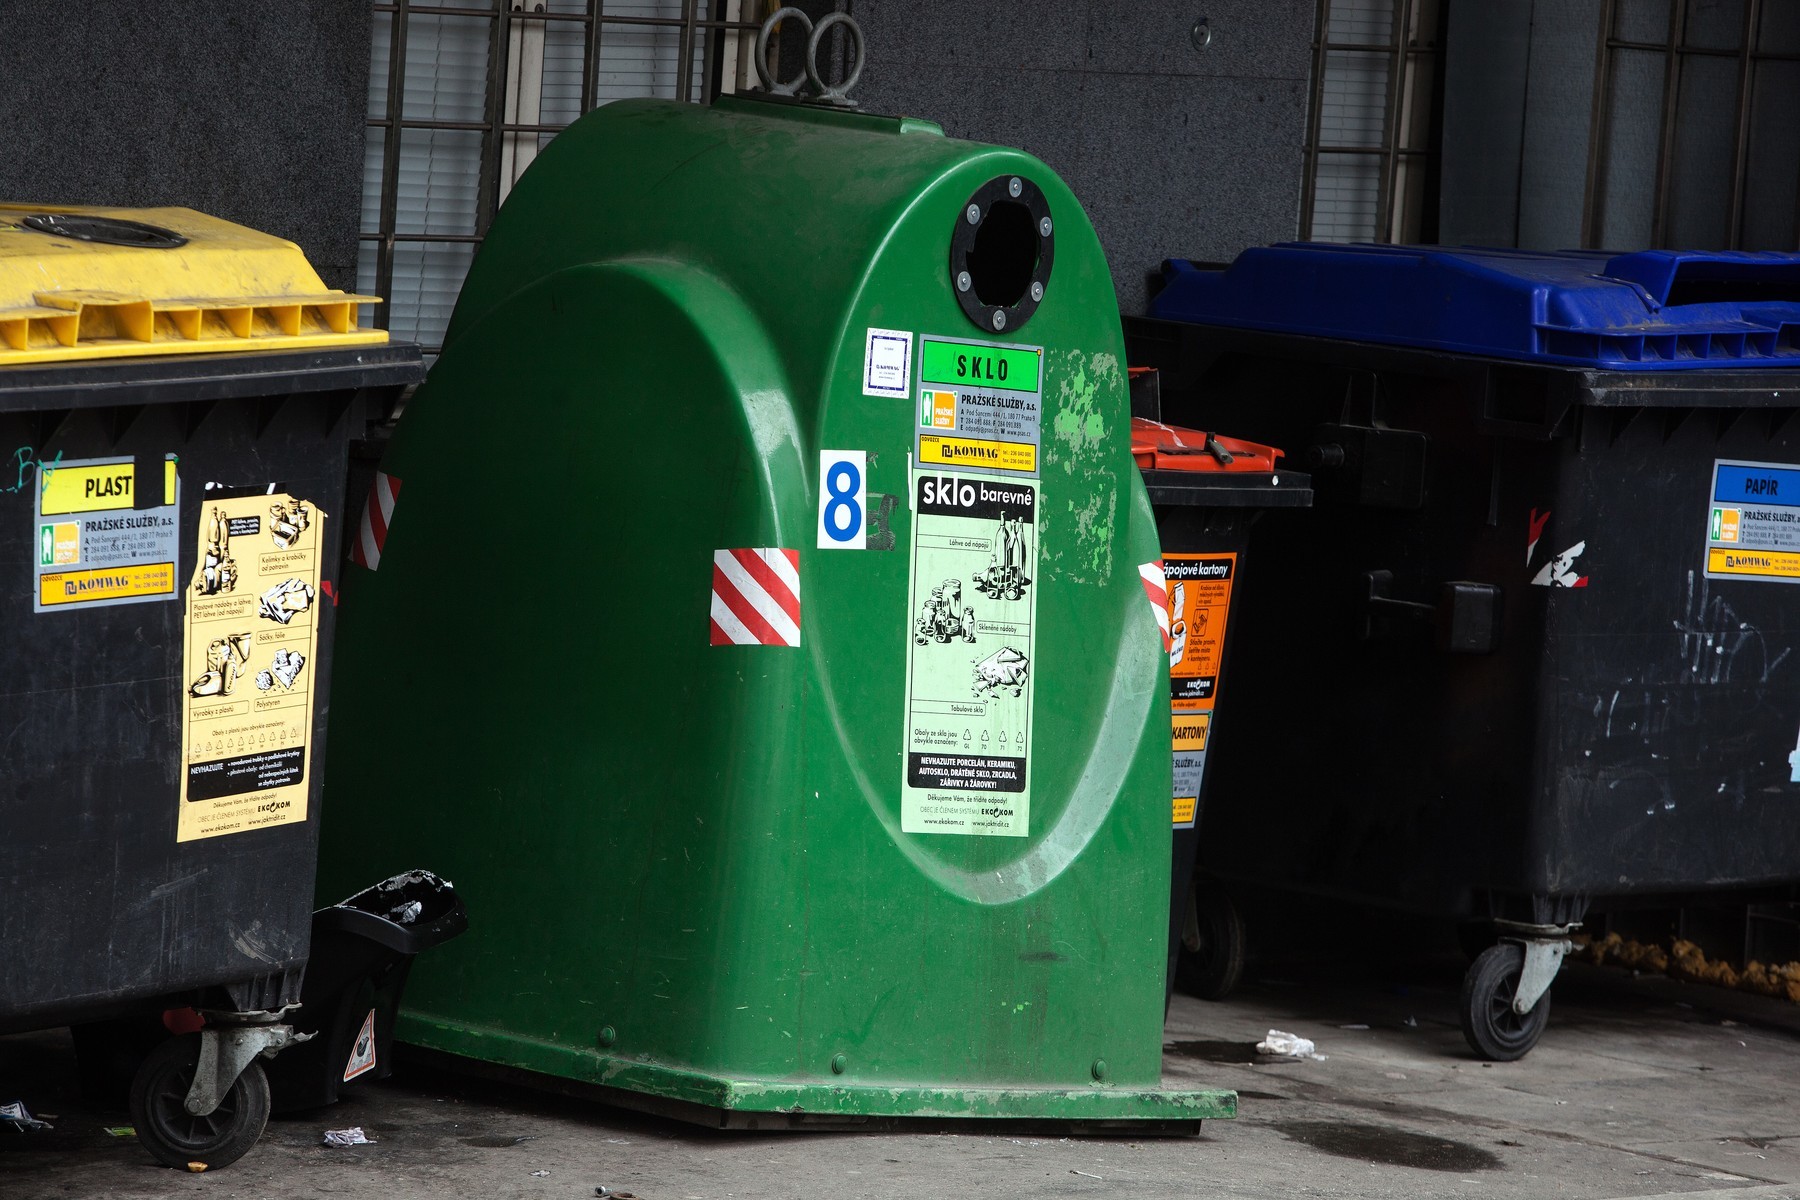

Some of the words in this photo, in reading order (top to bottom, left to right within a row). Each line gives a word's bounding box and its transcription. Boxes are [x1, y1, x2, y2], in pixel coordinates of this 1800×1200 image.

[957, 354, 1008, 381] SKLO
[961, 394, 996, 407] PRAŽSKÉ
[997, 397, 1026, 411] SLUŽBY,
[1026, 403, 1037, 411] a.s.
[953, 446, 999, 459] KOMWAG
[85, 475, 132, 498] PLAST
[922, 471, 976, 507] sklo
[980, 482, 1032, 506] barevné
[1745, 475, 1779, 496] PAPÍR
[823, 460, 862, 542] 8
[1744, 509, 1771, 522] PRAŽSKÉ
[85, 516, 124, 532] PRAŽSKÉ
[126, 515, 160, 529] SLUŽBY,
[161, 518, 174, 526] a.s.
[949, 539, 964, 547] Láhve
[972, 539, 989, 549] nápojů
[1164, 562, 1198, 578] ápojové
[1199, 562, 1228, 578] kartony
[78, 575, 129, 591] KOMWAG
[978, 623, 998, 632] Skleněné
[999, 625, 1017, 633] nádoby
[256, 699, 280, 708] Polystyren
[951, 705, 973, 713] Tabulové
[914, 729, 929, 737] Obaly
[947, 730, 957, 738] jsou
[1172, 726, 1207, 740] KARTONY
[914, 738, 933, 746] obvykle
[190, 763, 224, 775] NEVHAZUJTE
[920, 756, 956, 766] NEVHAZUJTE
[956, 757, 986, 768] PORCELÁN,
[987, 759, 1016, 769] KERAMIKU,
[919, 767, 950, 777] AUTOSKLO,
[976, 770, 991, 779] SKLO,
[992, 771, 1017, 780] ZRCADLA,
[939, 778, 964, 787] ZÁŘIVKY
[970, 779, 997, 789] ŽÁROVKY!
[927, 794, 952, 802] Děkujeme
[953, 794, 966, 803] Vám,
[988, 797, 1008, 805] odpady!
[200, 822, 241, 833] www.ekokom.cz
